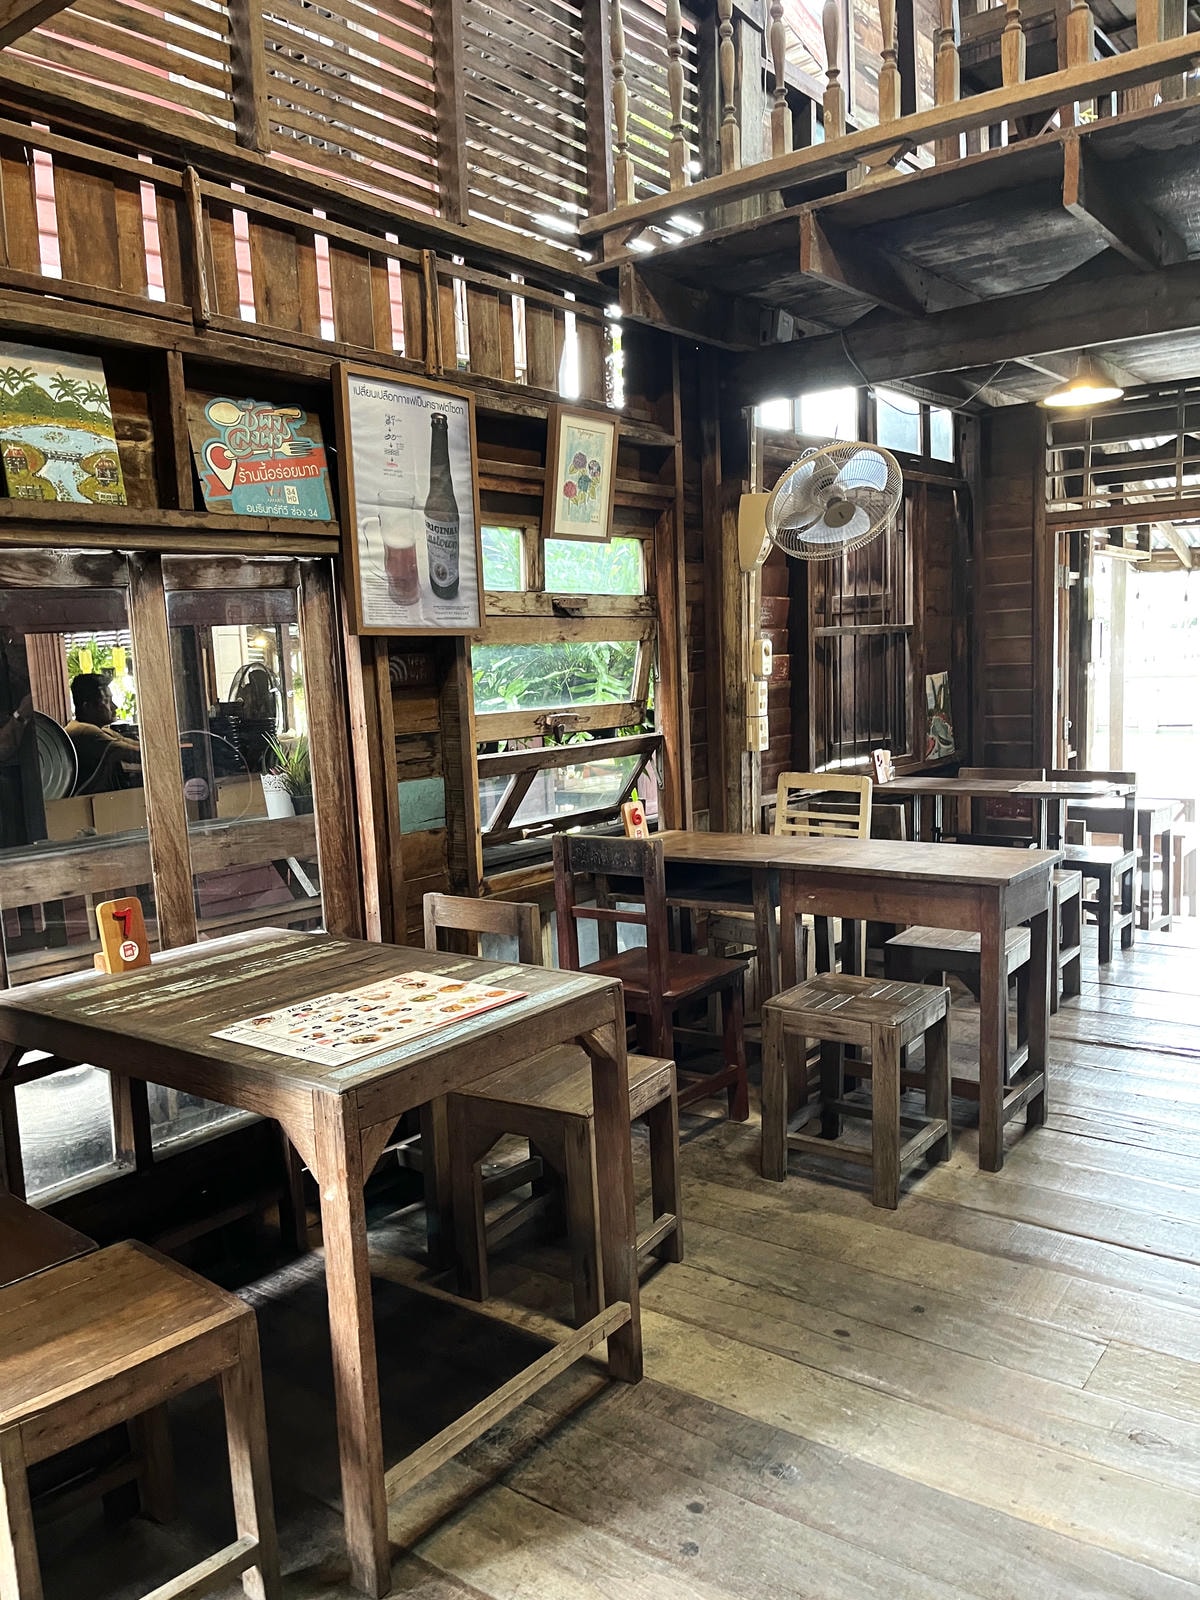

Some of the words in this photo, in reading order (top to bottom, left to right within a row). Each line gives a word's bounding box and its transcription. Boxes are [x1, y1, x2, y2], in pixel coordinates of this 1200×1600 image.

[239, 462, 319, 483] ร้านนี้อร่อยมาก
[247, 504, 288, 516] อมรินทร์ทีวี
[291, 506, 306, 517] ช่อง
[308, 508, 318, 517] 34
[630, 807, 642, 826] 6
[112, 907, 132, 938] 7
